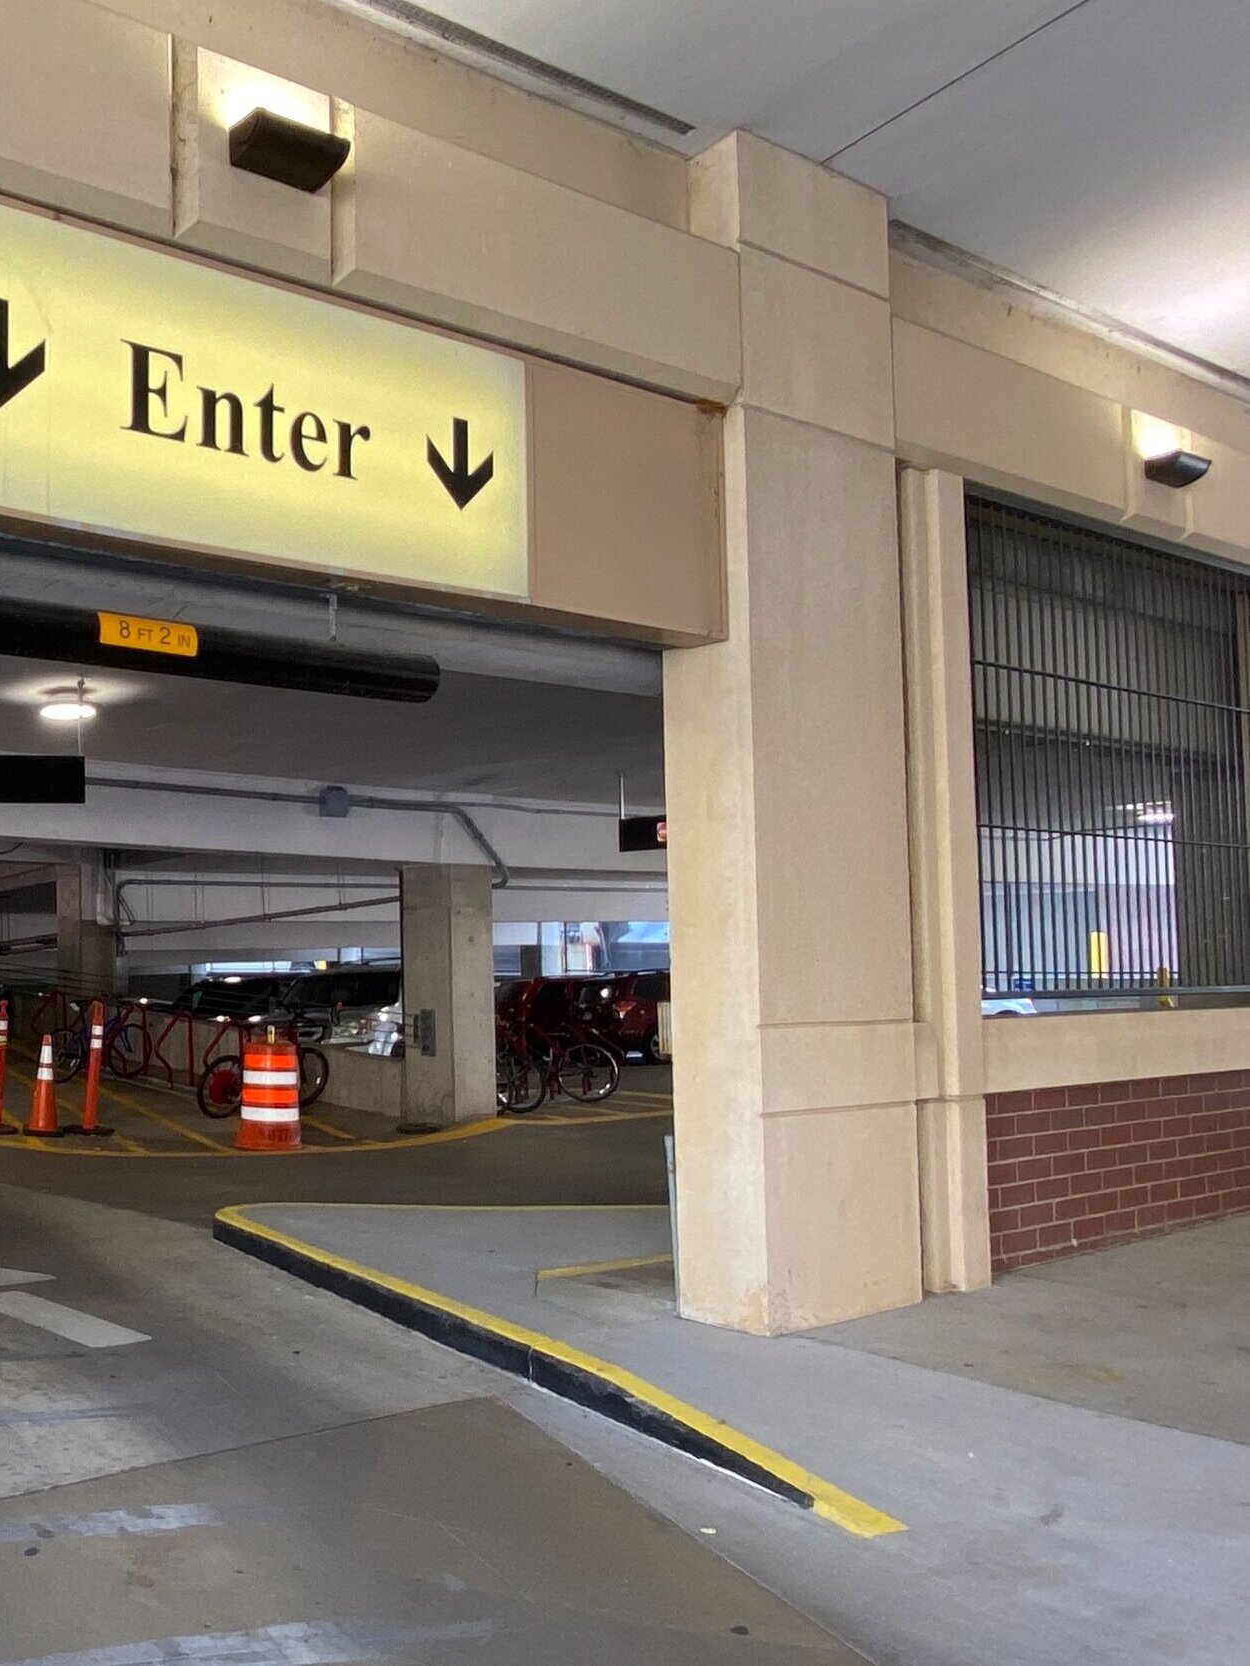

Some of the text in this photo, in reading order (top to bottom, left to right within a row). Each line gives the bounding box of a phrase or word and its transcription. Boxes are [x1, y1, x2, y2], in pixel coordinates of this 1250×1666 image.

[120, 339, 371, 480] Enter
[119, 620, 191, 648] 8 FT 2 IN
